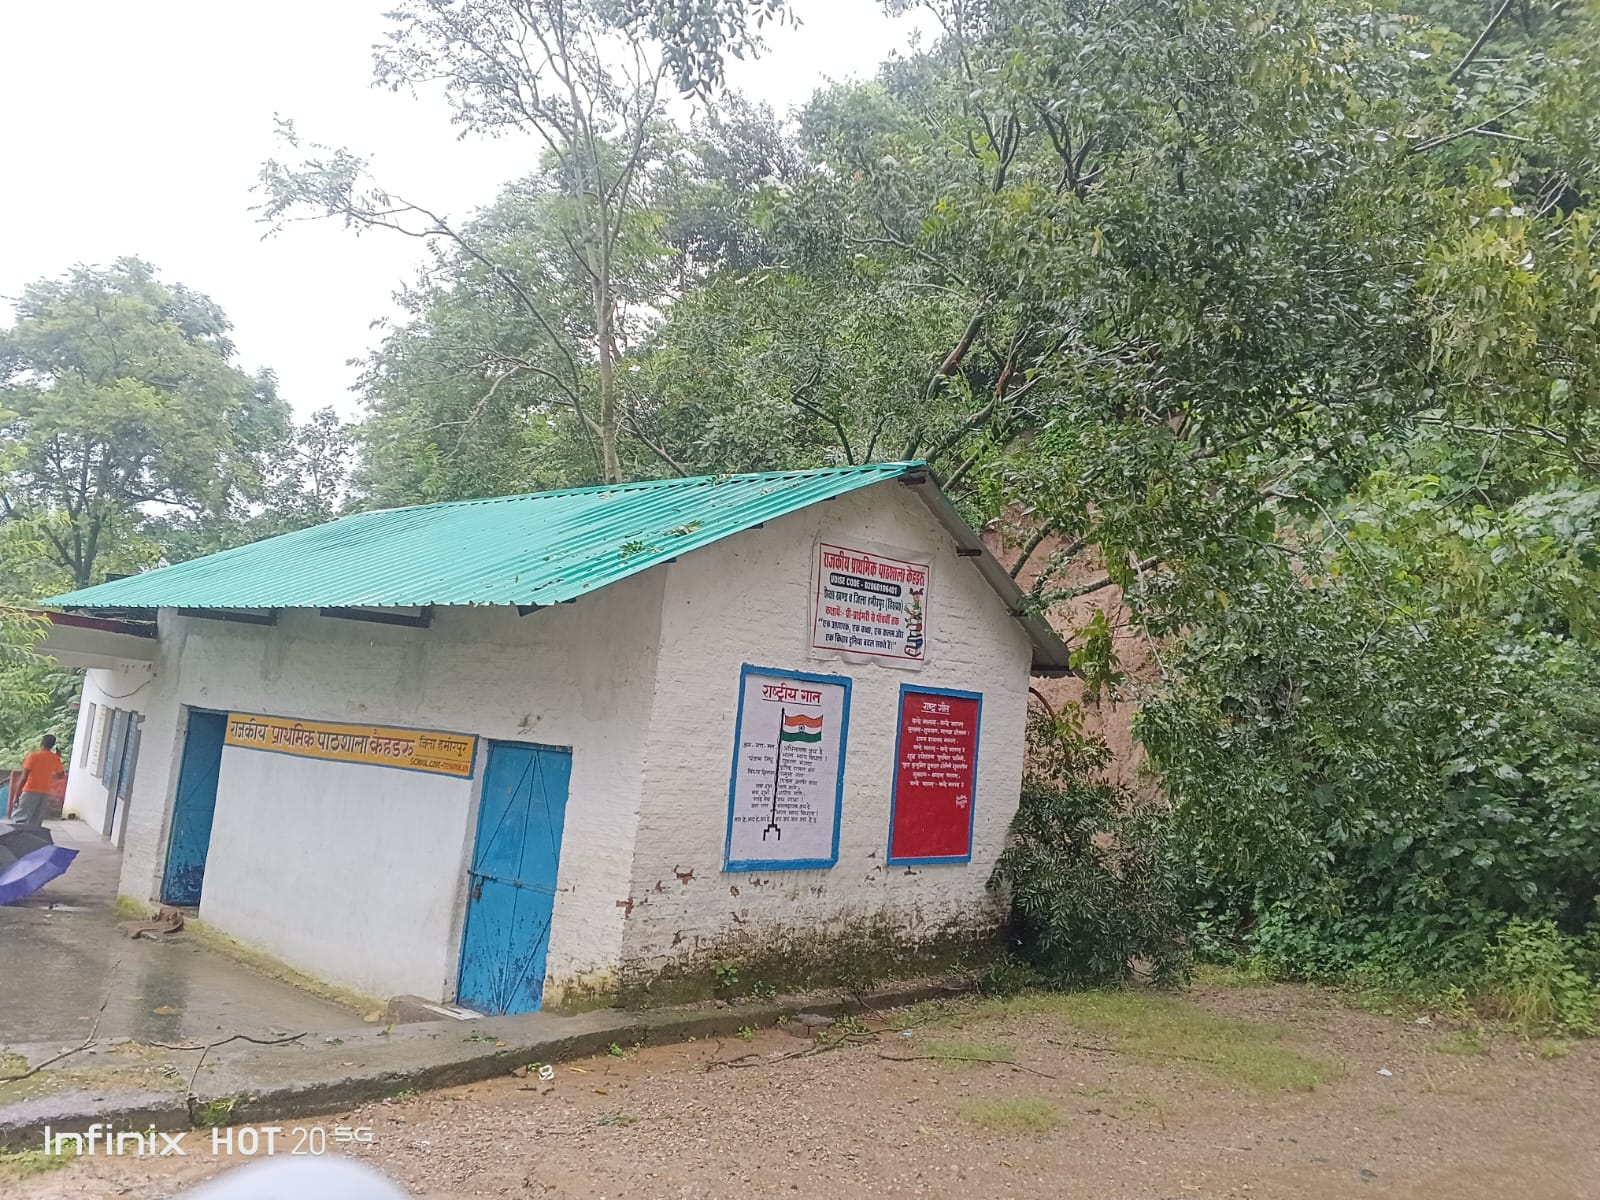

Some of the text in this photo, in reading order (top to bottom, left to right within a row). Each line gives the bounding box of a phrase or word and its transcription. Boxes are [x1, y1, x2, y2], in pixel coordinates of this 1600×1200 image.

[824, 550, 850, 572] राजकीय
[851, 556, 877, 577] प्राथमिक
[879, 563, 905, 583] पाठशाला
[830, 574, 846, 585] UDISE
[846, 576, 860, 587] CODE
[762, 682, 823, 704] राष्ट्रीय गान
[230, 718, 269, 741] राजकीय
[271, 723, 315, 747] प्राथमिक
[316, 731, 370, 755] पाठशाला
[419, 735, 437, 750] जिला
